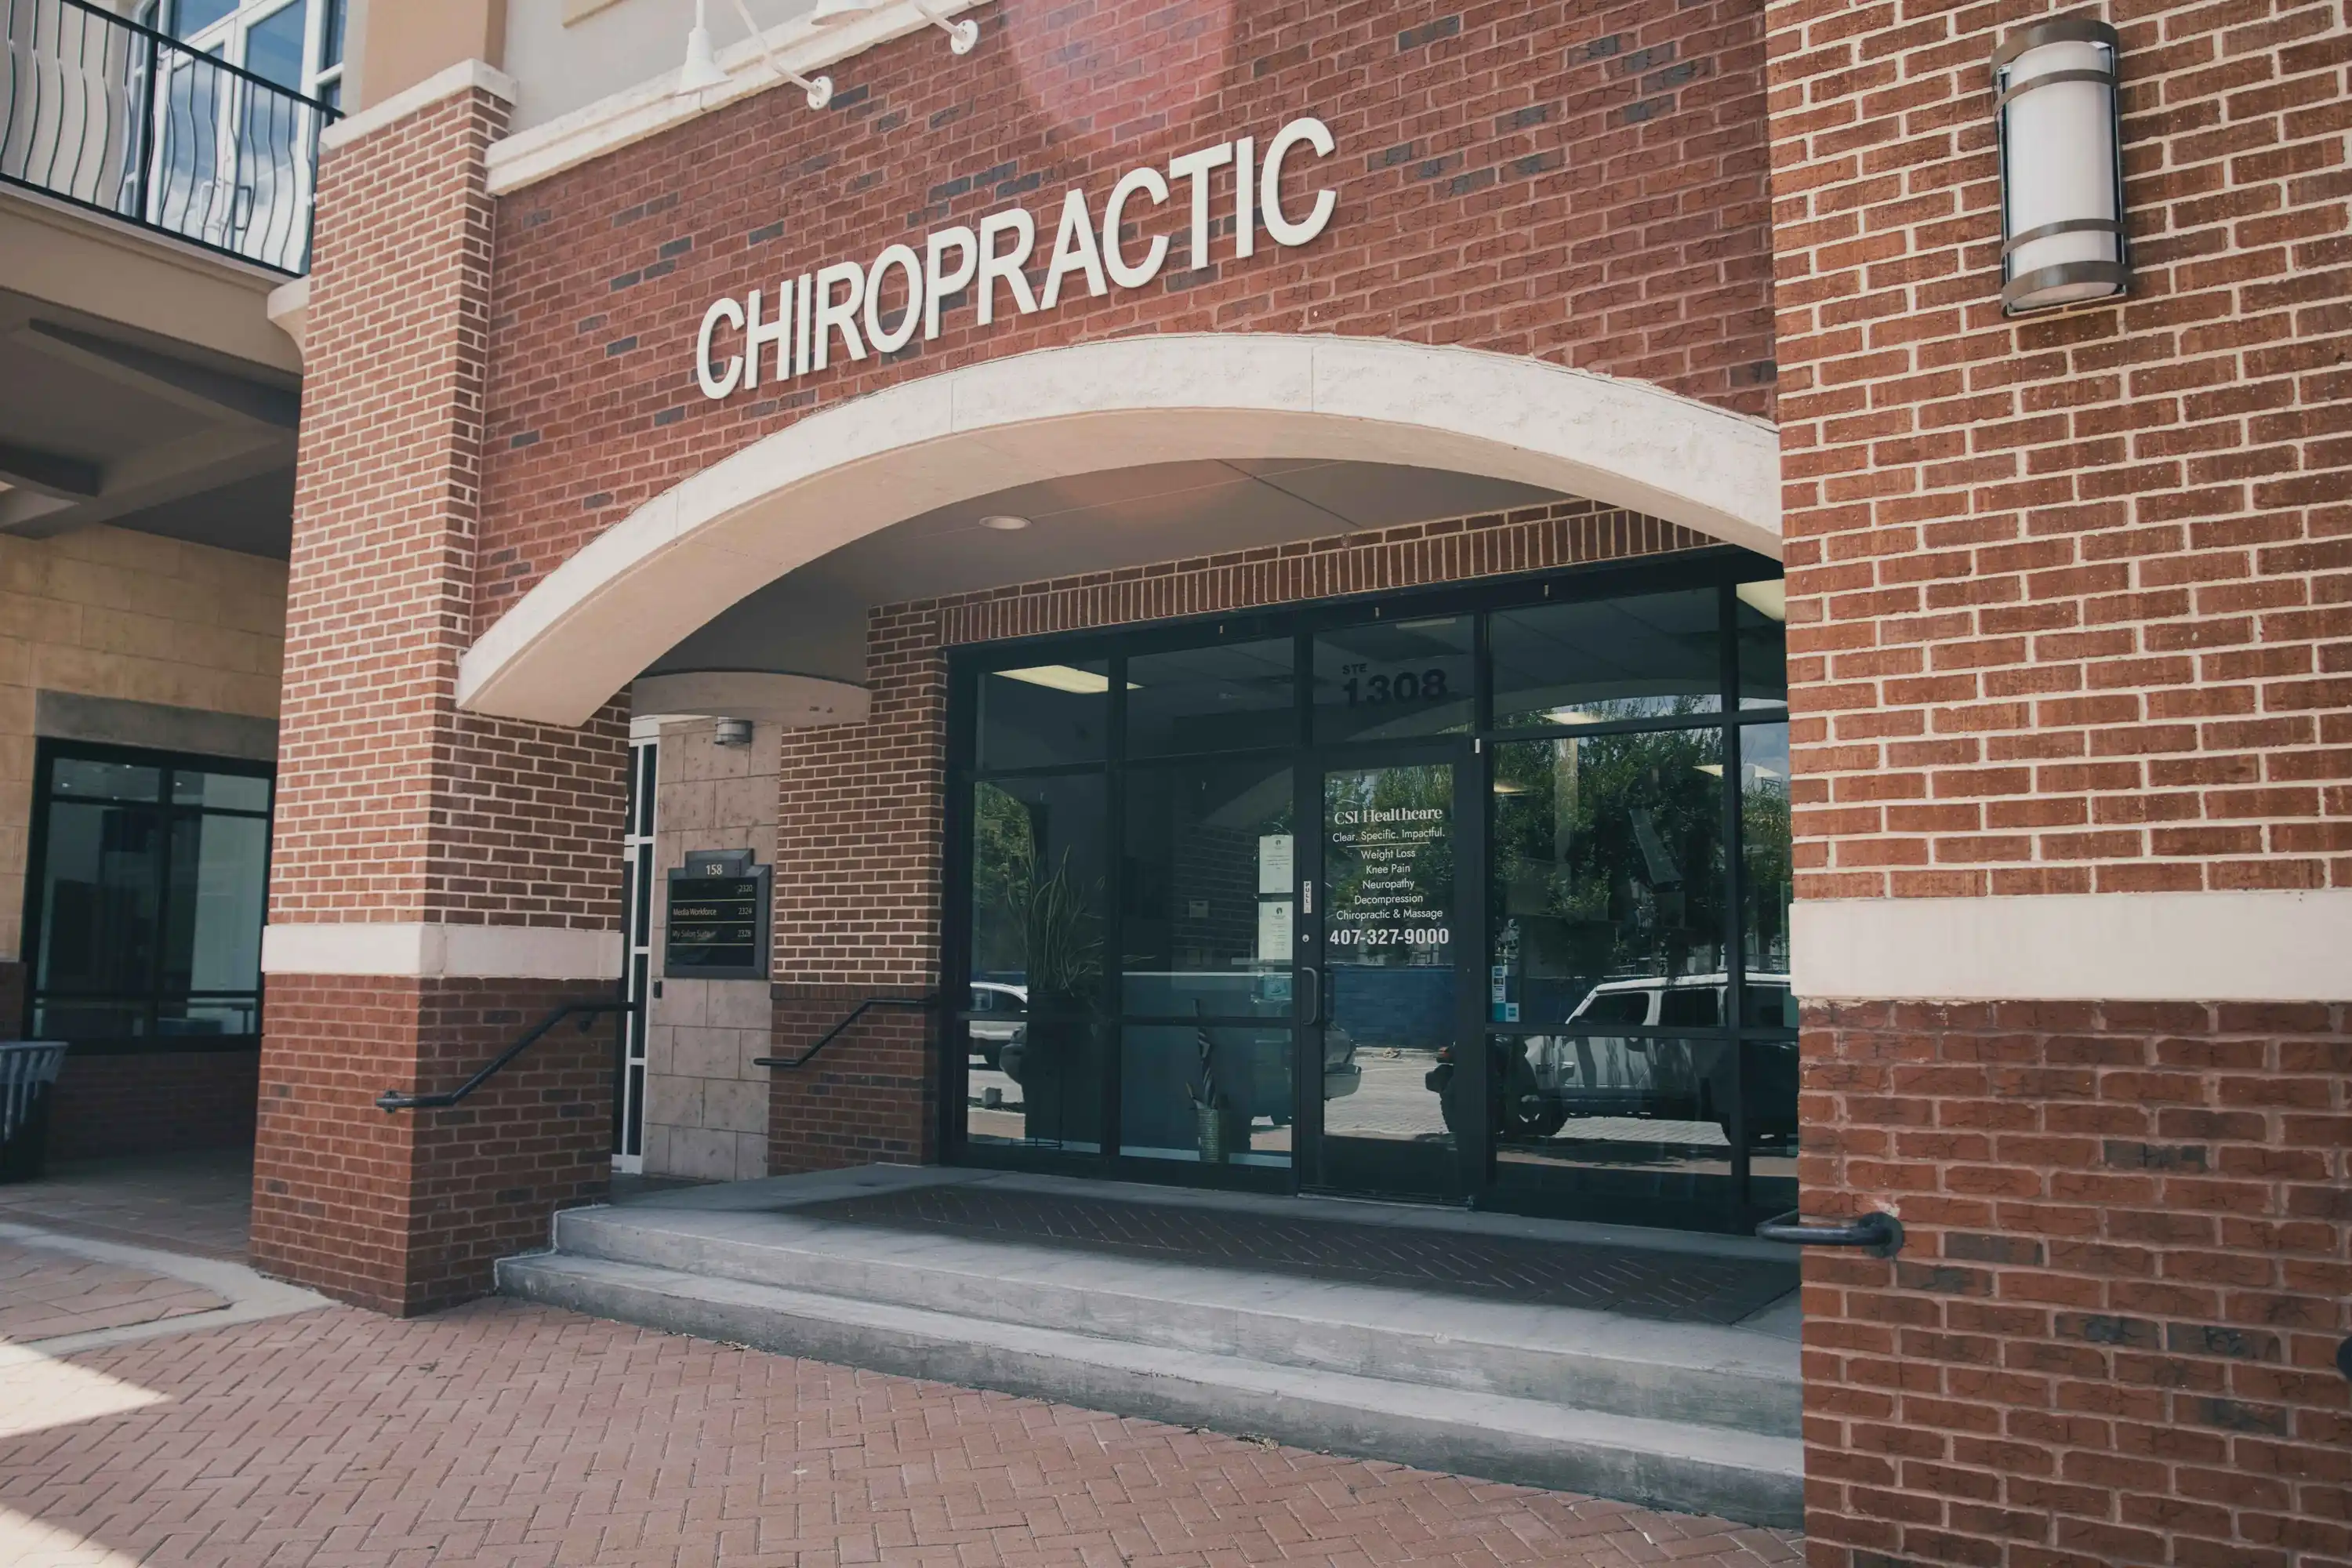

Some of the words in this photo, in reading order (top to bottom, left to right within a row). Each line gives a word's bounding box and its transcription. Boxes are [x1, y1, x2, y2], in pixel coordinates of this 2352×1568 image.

[696, 117, 1337, 400] CHIROPRACTIC
[1342, 662, 1367, 675] STE
[1341, 669, 1447, 707] 1308
[1334, 810, 1359, 825] CSI
[1363, 808, 1443, 823] Healthcare
[1333, 833, 1358, 843] Clear.
[1361, 829, 1399, 842] Specific.
[1402, 826, 1445, 840] Impactful.
[1360, 848, 1394, 862] Weight
[1396, 849, 1416, 858] Loss
[706, 864, 723, 876] 158
[1366, 865, 1388, 874] Knee
[1391, 863, 1410, 873] Pain
[1363, 877, 1414, 891] Neuropathy
[1354, 894, 1423, 906] Decompression
[690, 907, 717, 916] Workforce
[1336, 909, 1390, 921] Chiropractic
[1393, 909, 1401, 918] &
[1403, 909, 1443, 920] Massage
[1330, 928, 1449, 945] 407-327-9000
